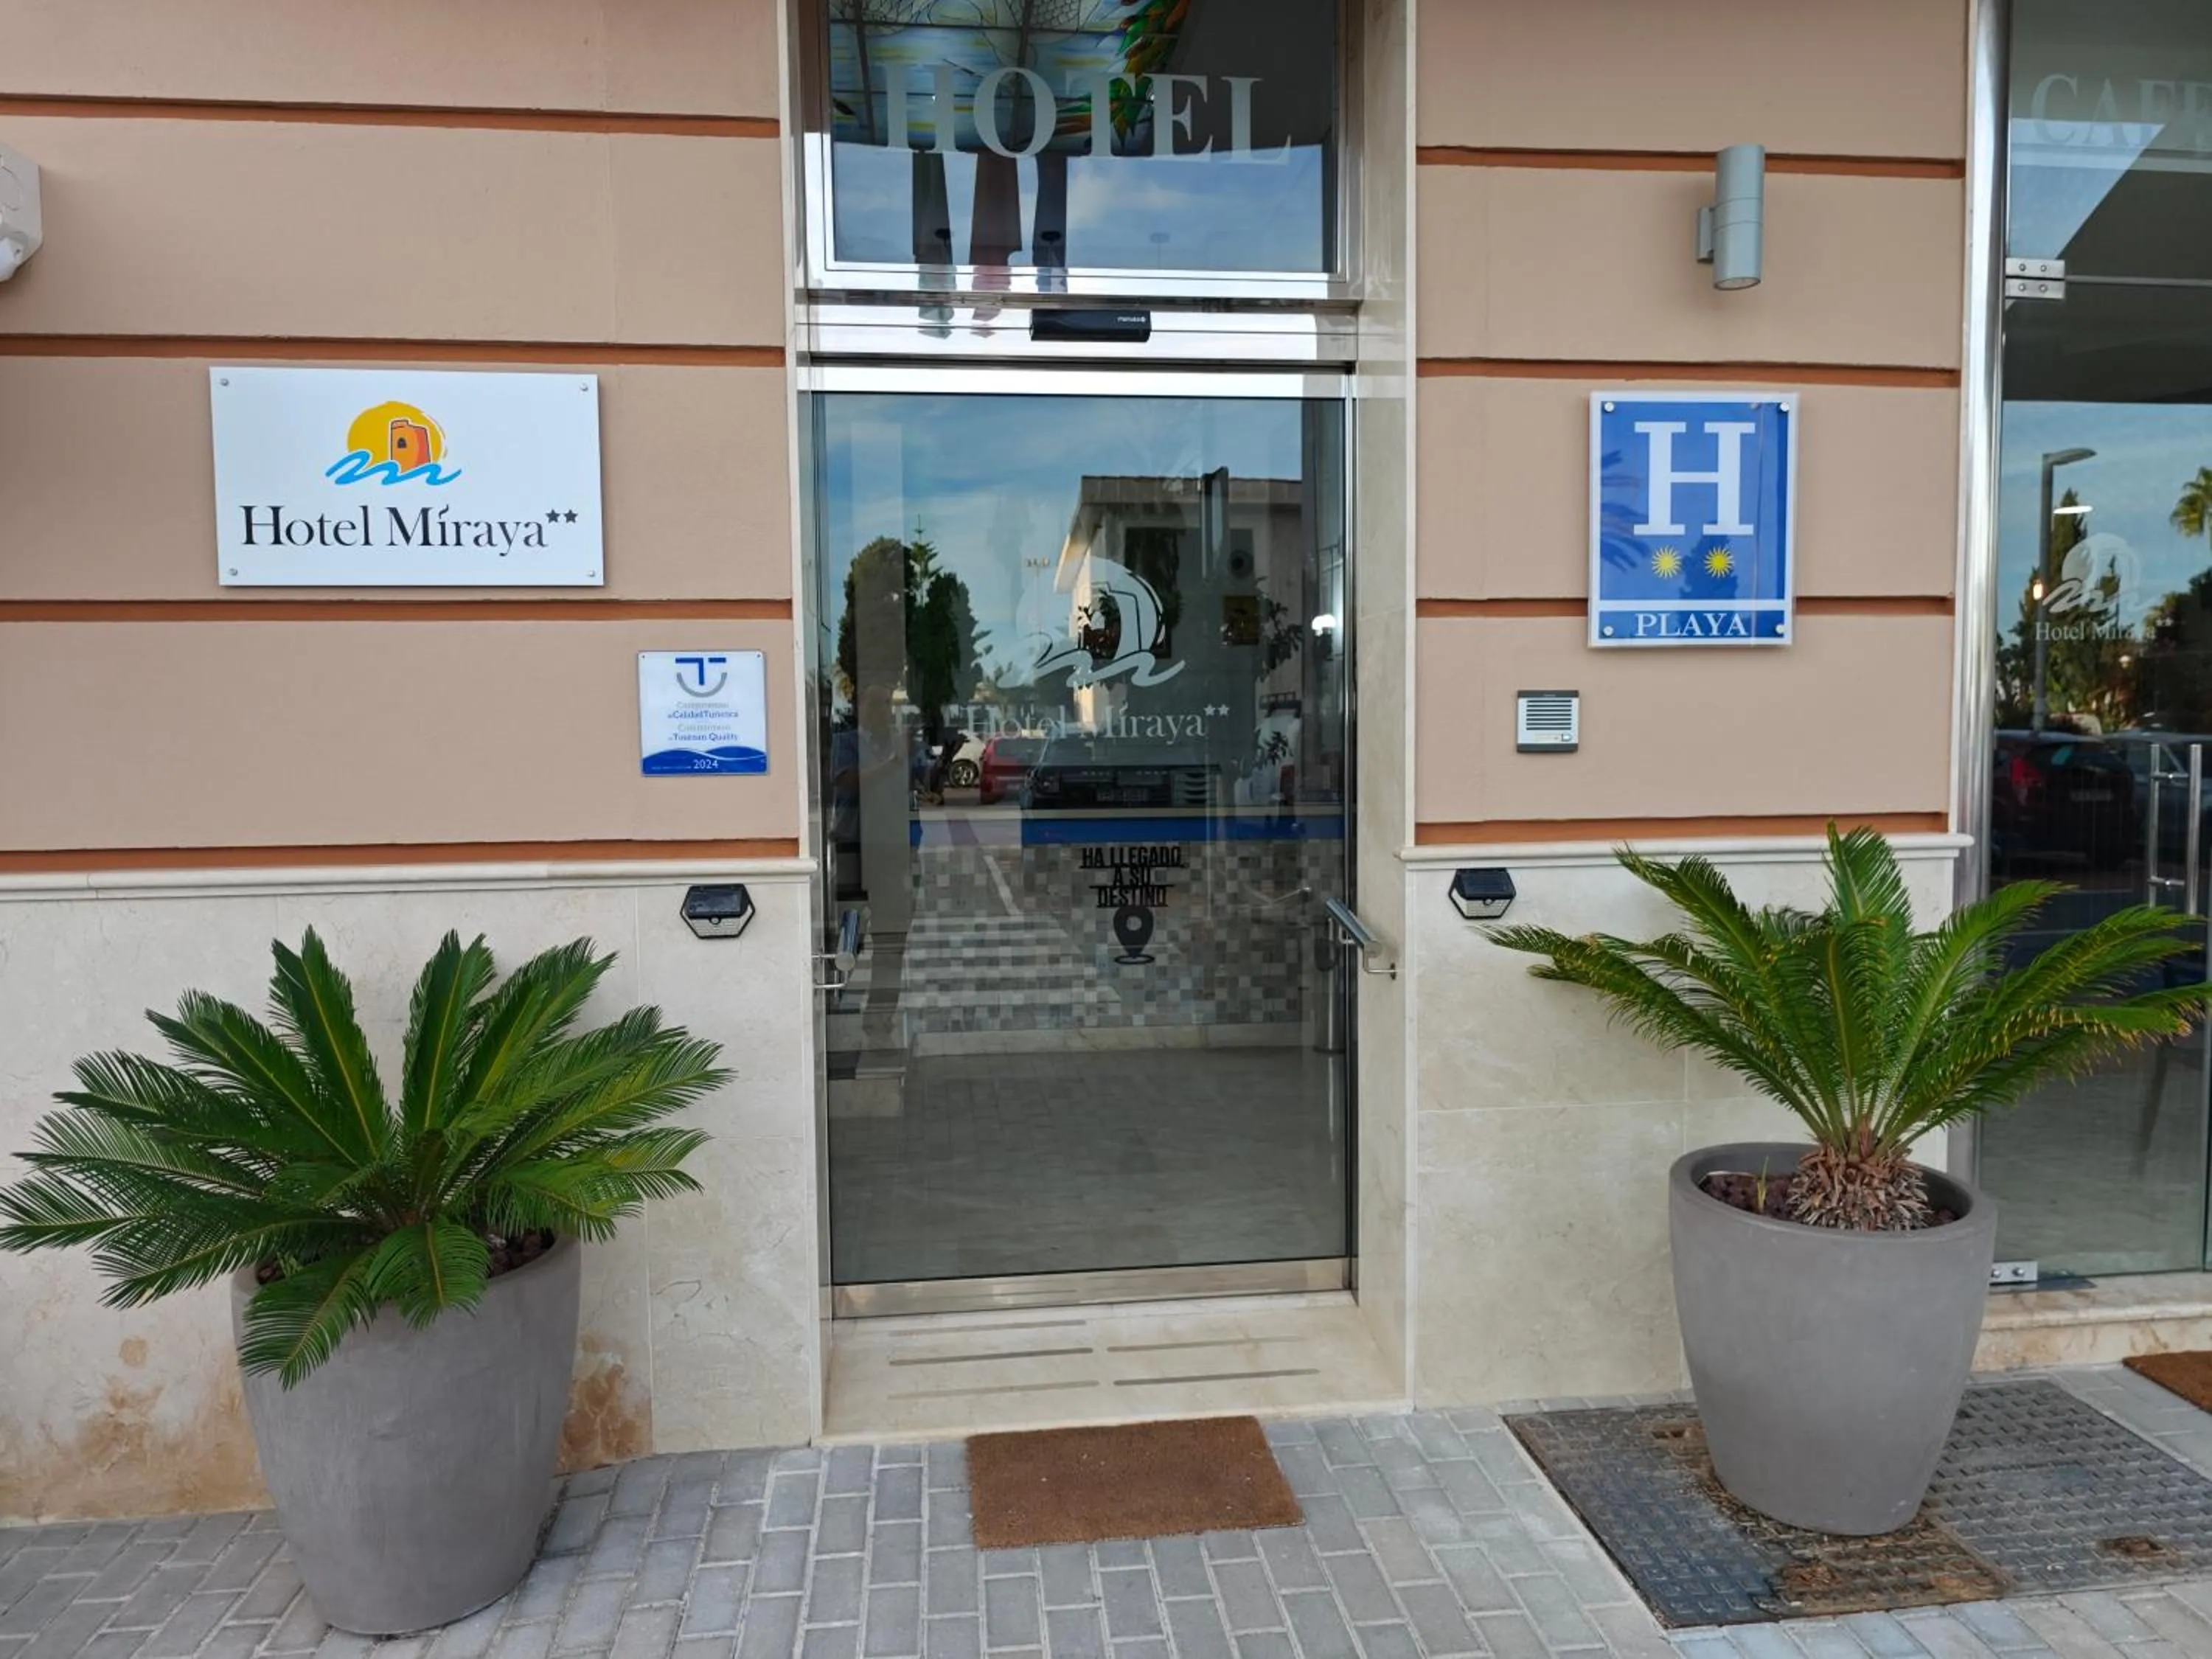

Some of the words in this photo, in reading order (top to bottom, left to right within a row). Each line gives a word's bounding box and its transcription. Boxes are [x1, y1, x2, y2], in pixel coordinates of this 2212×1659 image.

[877, 64, 1293, 165] HOTEL
[1633, 422, 1756, 535] H
[240, 504, 374, 547] Hotel
[386, 504, 549, 557] Míraya
[1635, 613, 1748, 636] PLAYA
[2035, 622, 2085, 641] Hotel
[960, 705, 1067, 738] Hotel
[693, 759, 719, 769] 2024
[1082, 847, 1105, 867] HA
[1109, 846, 1181, 866] LLEGADO
[1113, 866, 1124, 886] A
[1129, 864, 1151, 886] SU
[1098, 886, 1167, 906] DESTINO
